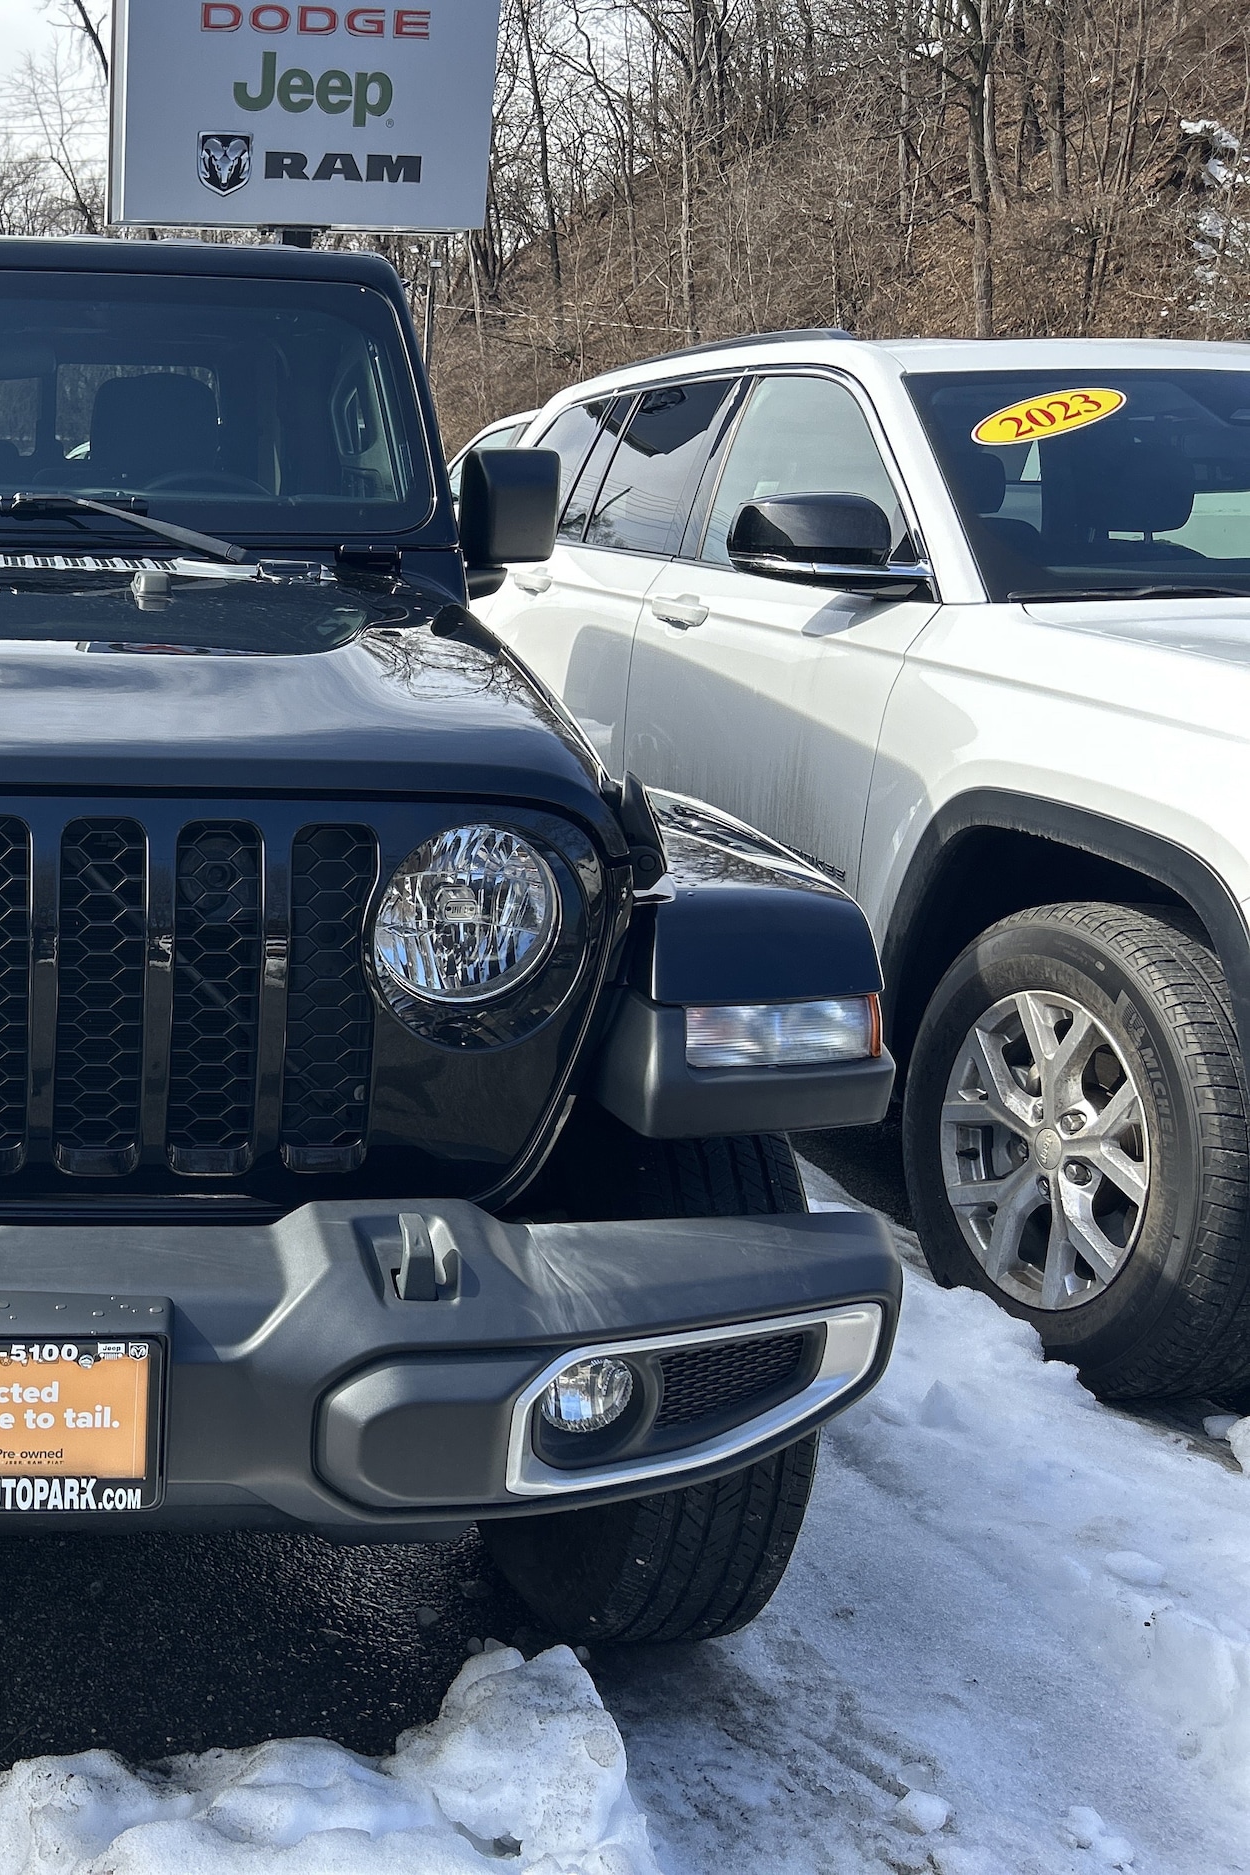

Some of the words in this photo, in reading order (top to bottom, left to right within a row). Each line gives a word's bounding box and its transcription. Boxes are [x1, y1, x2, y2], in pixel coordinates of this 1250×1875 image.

[200, 2, 431, 40] DODGE
[233, 51, 393, 127] Jeep
[264, 151, 422, 183] RAM
[999, 393, 1102, 438] 2023
[24, 1408, 55, 1429] to
[63, 1404, 120, 1429] tail.
